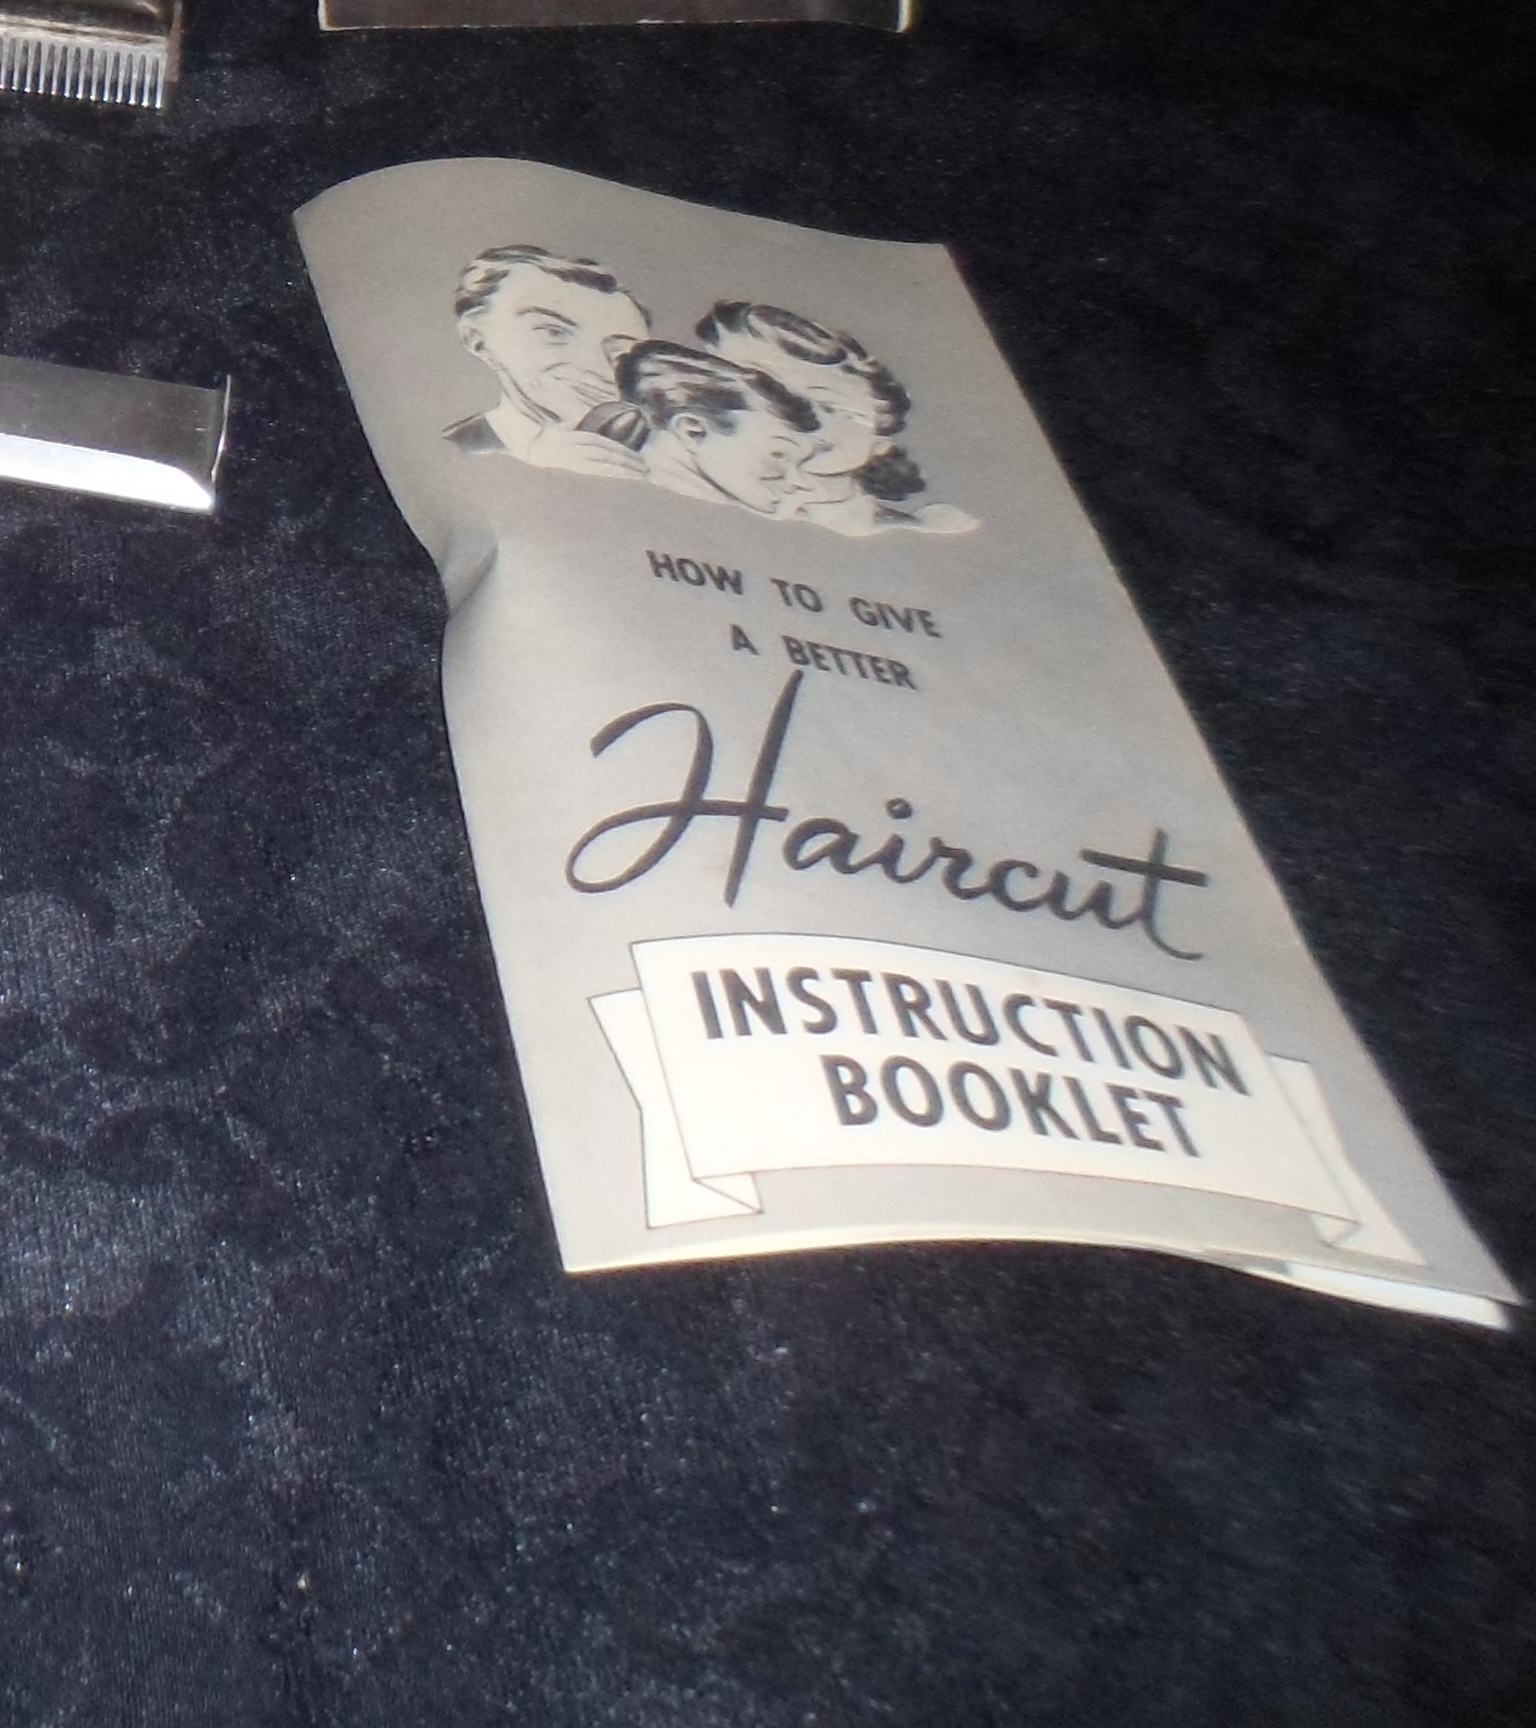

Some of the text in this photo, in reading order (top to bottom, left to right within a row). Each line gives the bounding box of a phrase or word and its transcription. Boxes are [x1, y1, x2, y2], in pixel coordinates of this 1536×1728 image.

[645, 549, 944, 639] HOW TO GIVE
[730, 625, 919, 691] A BETTER
[564, 670, 1208, 961] Haircut
[690, 968, 1254, 1098] INSTRUCTION
[817, 1054, 1202, 1158] BOOKLET
